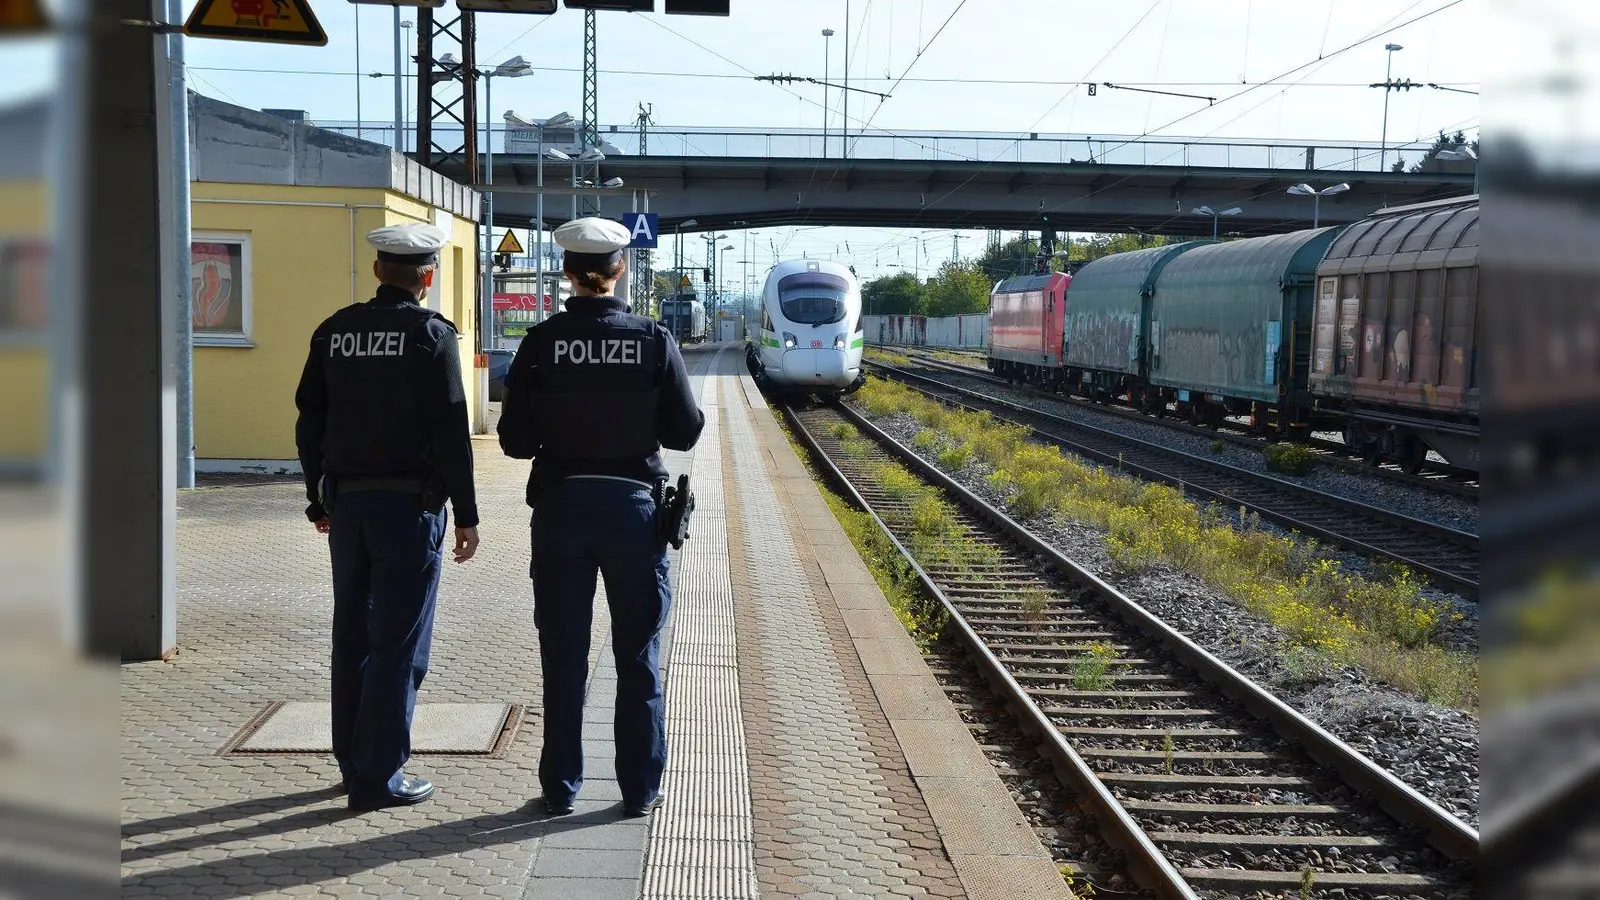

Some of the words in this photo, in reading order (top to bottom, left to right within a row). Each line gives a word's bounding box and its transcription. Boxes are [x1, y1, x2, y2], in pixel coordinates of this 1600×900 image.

[1089, 85, 1095, 95] 3
[631, 214, 653, 240] A
[329, 332, 406, 358] POLIZEI
[554, 339, 642, 364] POLIZEI
